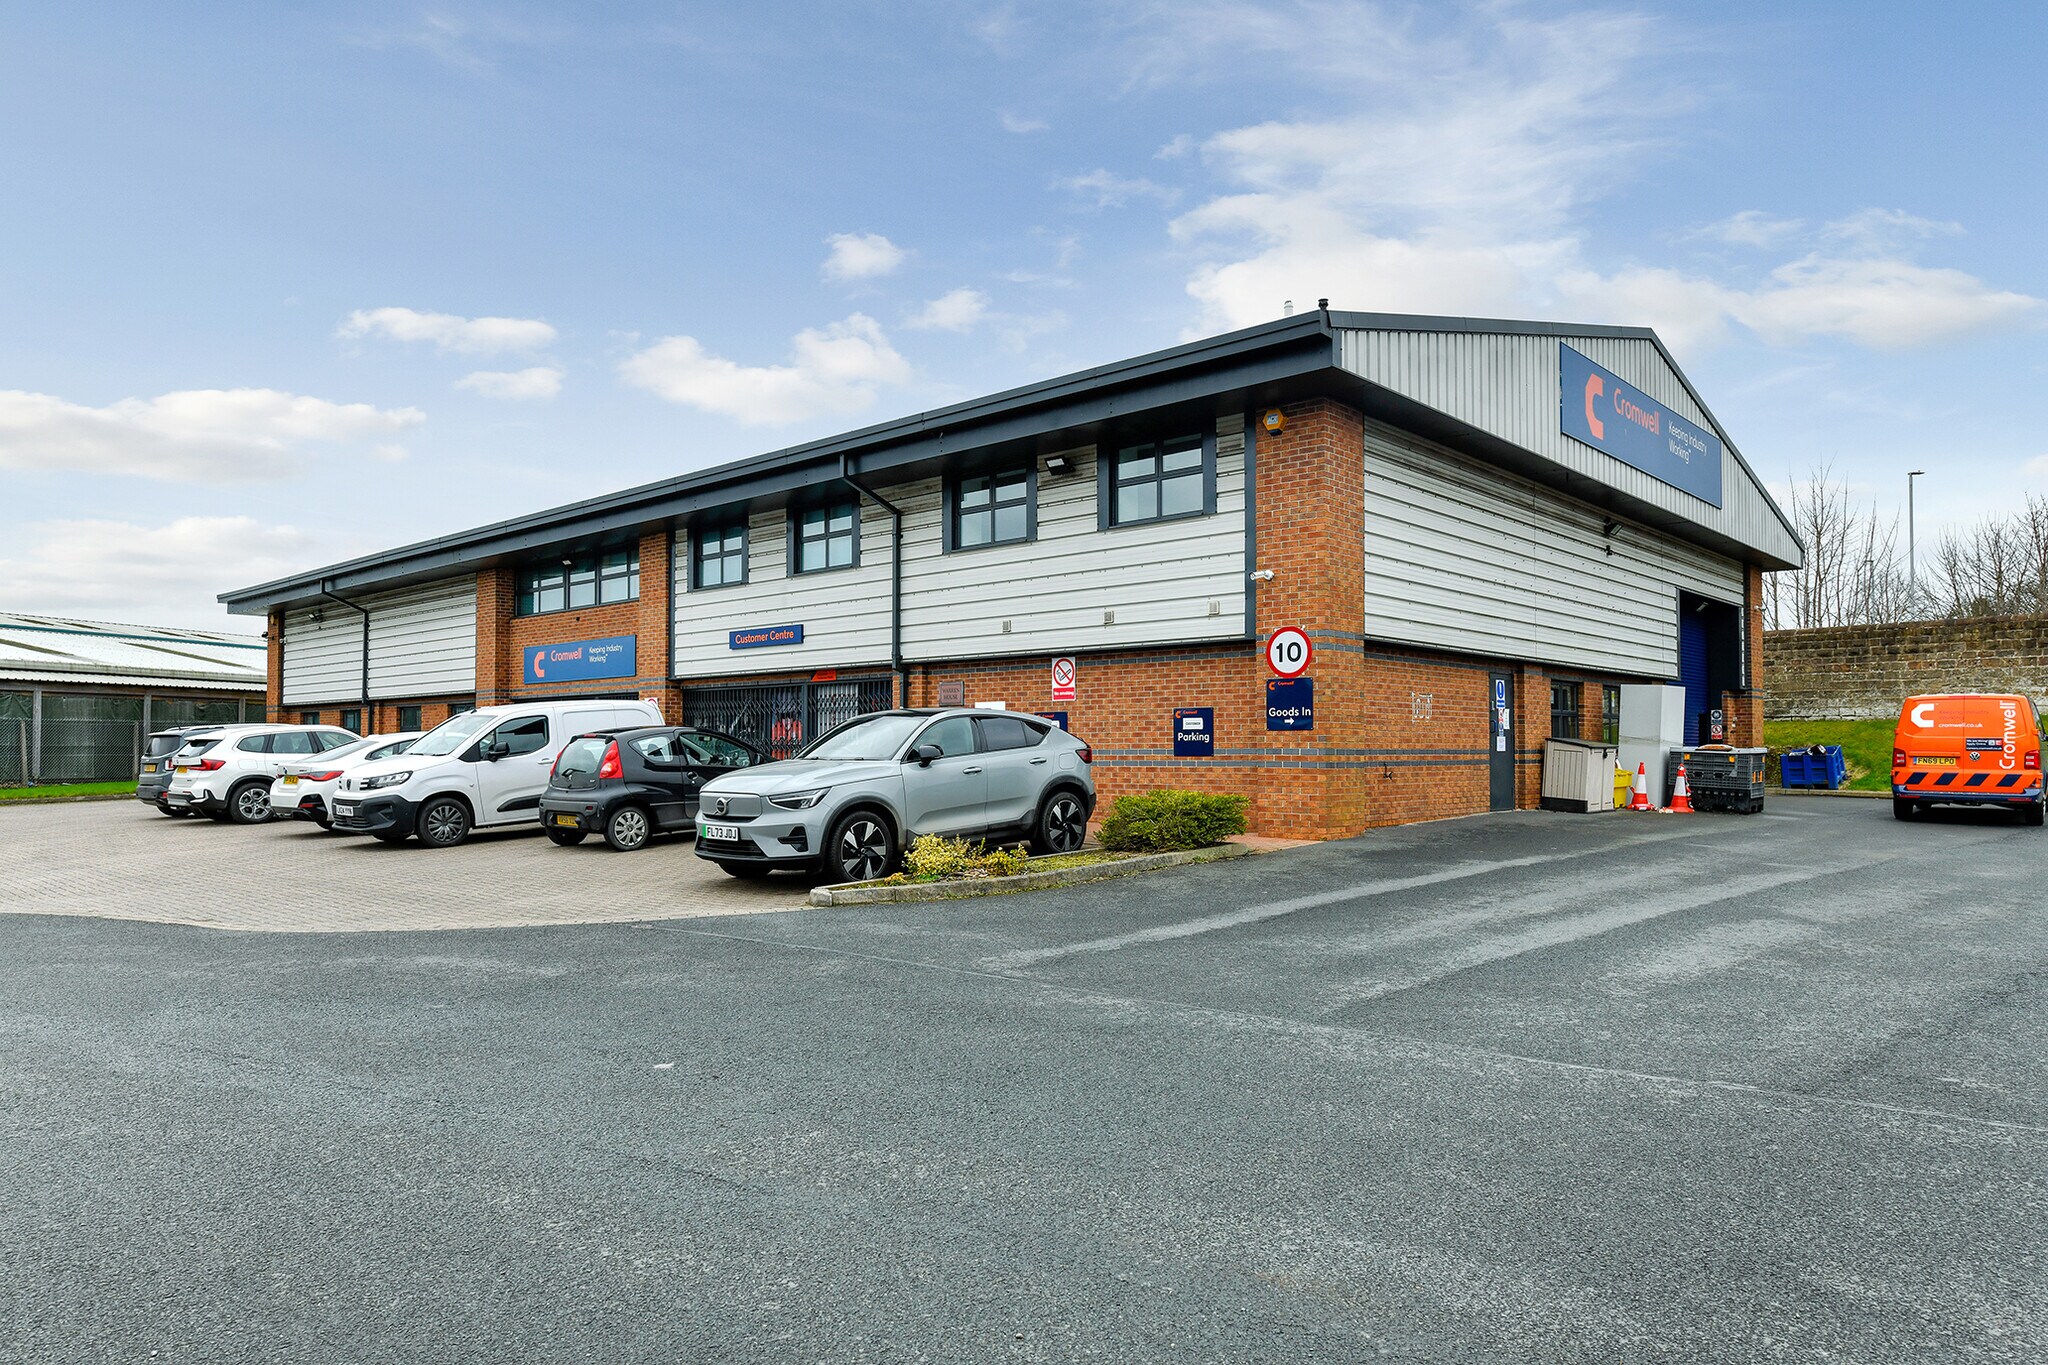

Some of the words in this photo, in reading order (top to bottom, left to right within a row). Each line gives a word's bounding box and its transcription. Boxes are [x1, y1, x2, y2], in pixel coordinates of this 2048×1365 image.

[1613, 388, 1660, 435] Cromwell
[1668, 420, 1689, 446] Keeping
[1688, 432, 1708, 456] Industry
[735, 633, 769, 645] Customer
[769, 630, 794, 641] Centre
[550, 647, 583, 662] Cromwell
[589, 646, 606, 655] Keeping
[606, 644, 624, 653] Industry
[1275, 641, 1302, 662] 10
[1268, 706, 1300, 718] Goods
[1302, 706, 1312, 717] In
[1177, 732, 1210, 743] Parking
[1999, 700, 2017, 770] Cromwell
[1917, 757, 1938, 765] FN69
[706, 827, 722, 838] FL73
